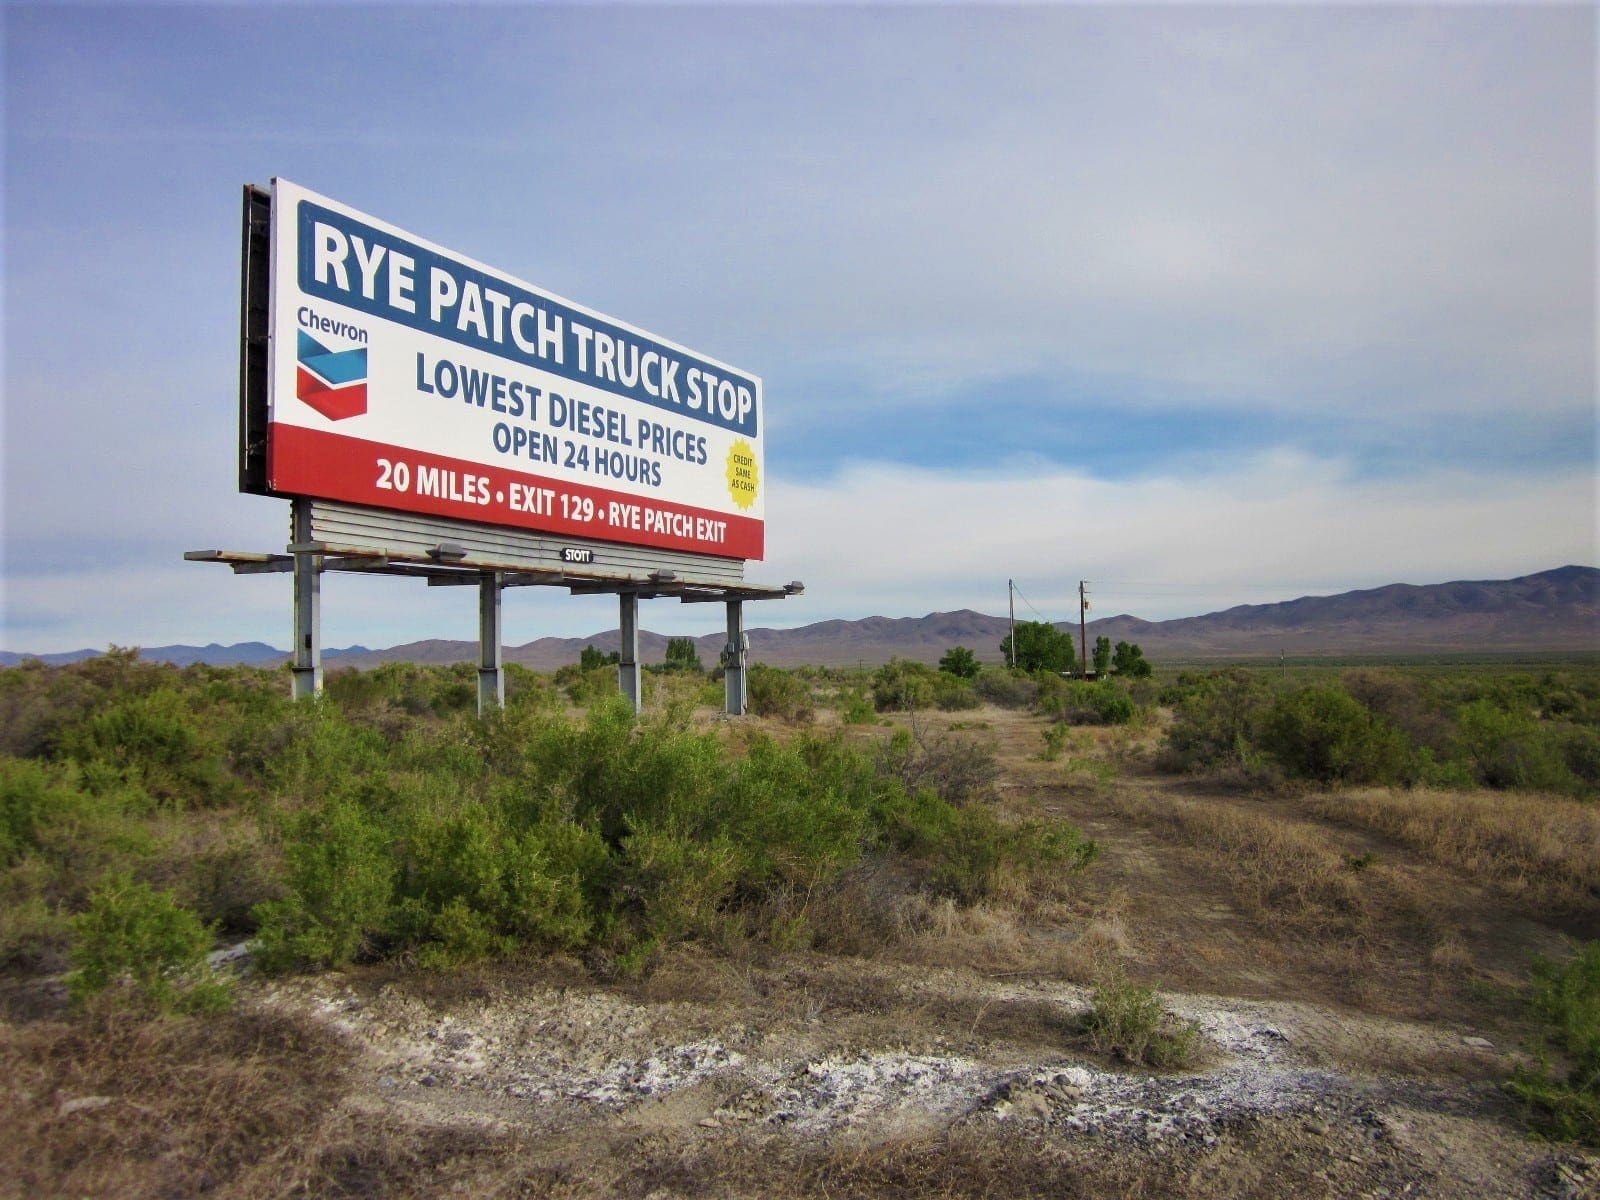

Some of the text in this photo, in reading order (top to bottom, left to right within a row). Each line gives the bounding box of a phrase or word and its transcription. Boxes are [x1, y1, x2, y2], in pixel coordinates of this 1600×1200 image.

[297, 306, 368, 344] Chevron
[314, 221, 752, 425] RYE PATCH TRUCK STOP
[416, 351, 708, 466] LOWEST DIESEL PRICES
[493, 422, 662, 487] OPEN 24 HOURS
[733, 453, 753, 468] CREDIT
[731, 478, 755, 493] AS CASH
[735, 468, 751, 480] SAME
[375, 458, 727, 544] 20 MILES EXIT 129 RYE PATCH EXIT
[565, 548, 591, 562] STOTT
